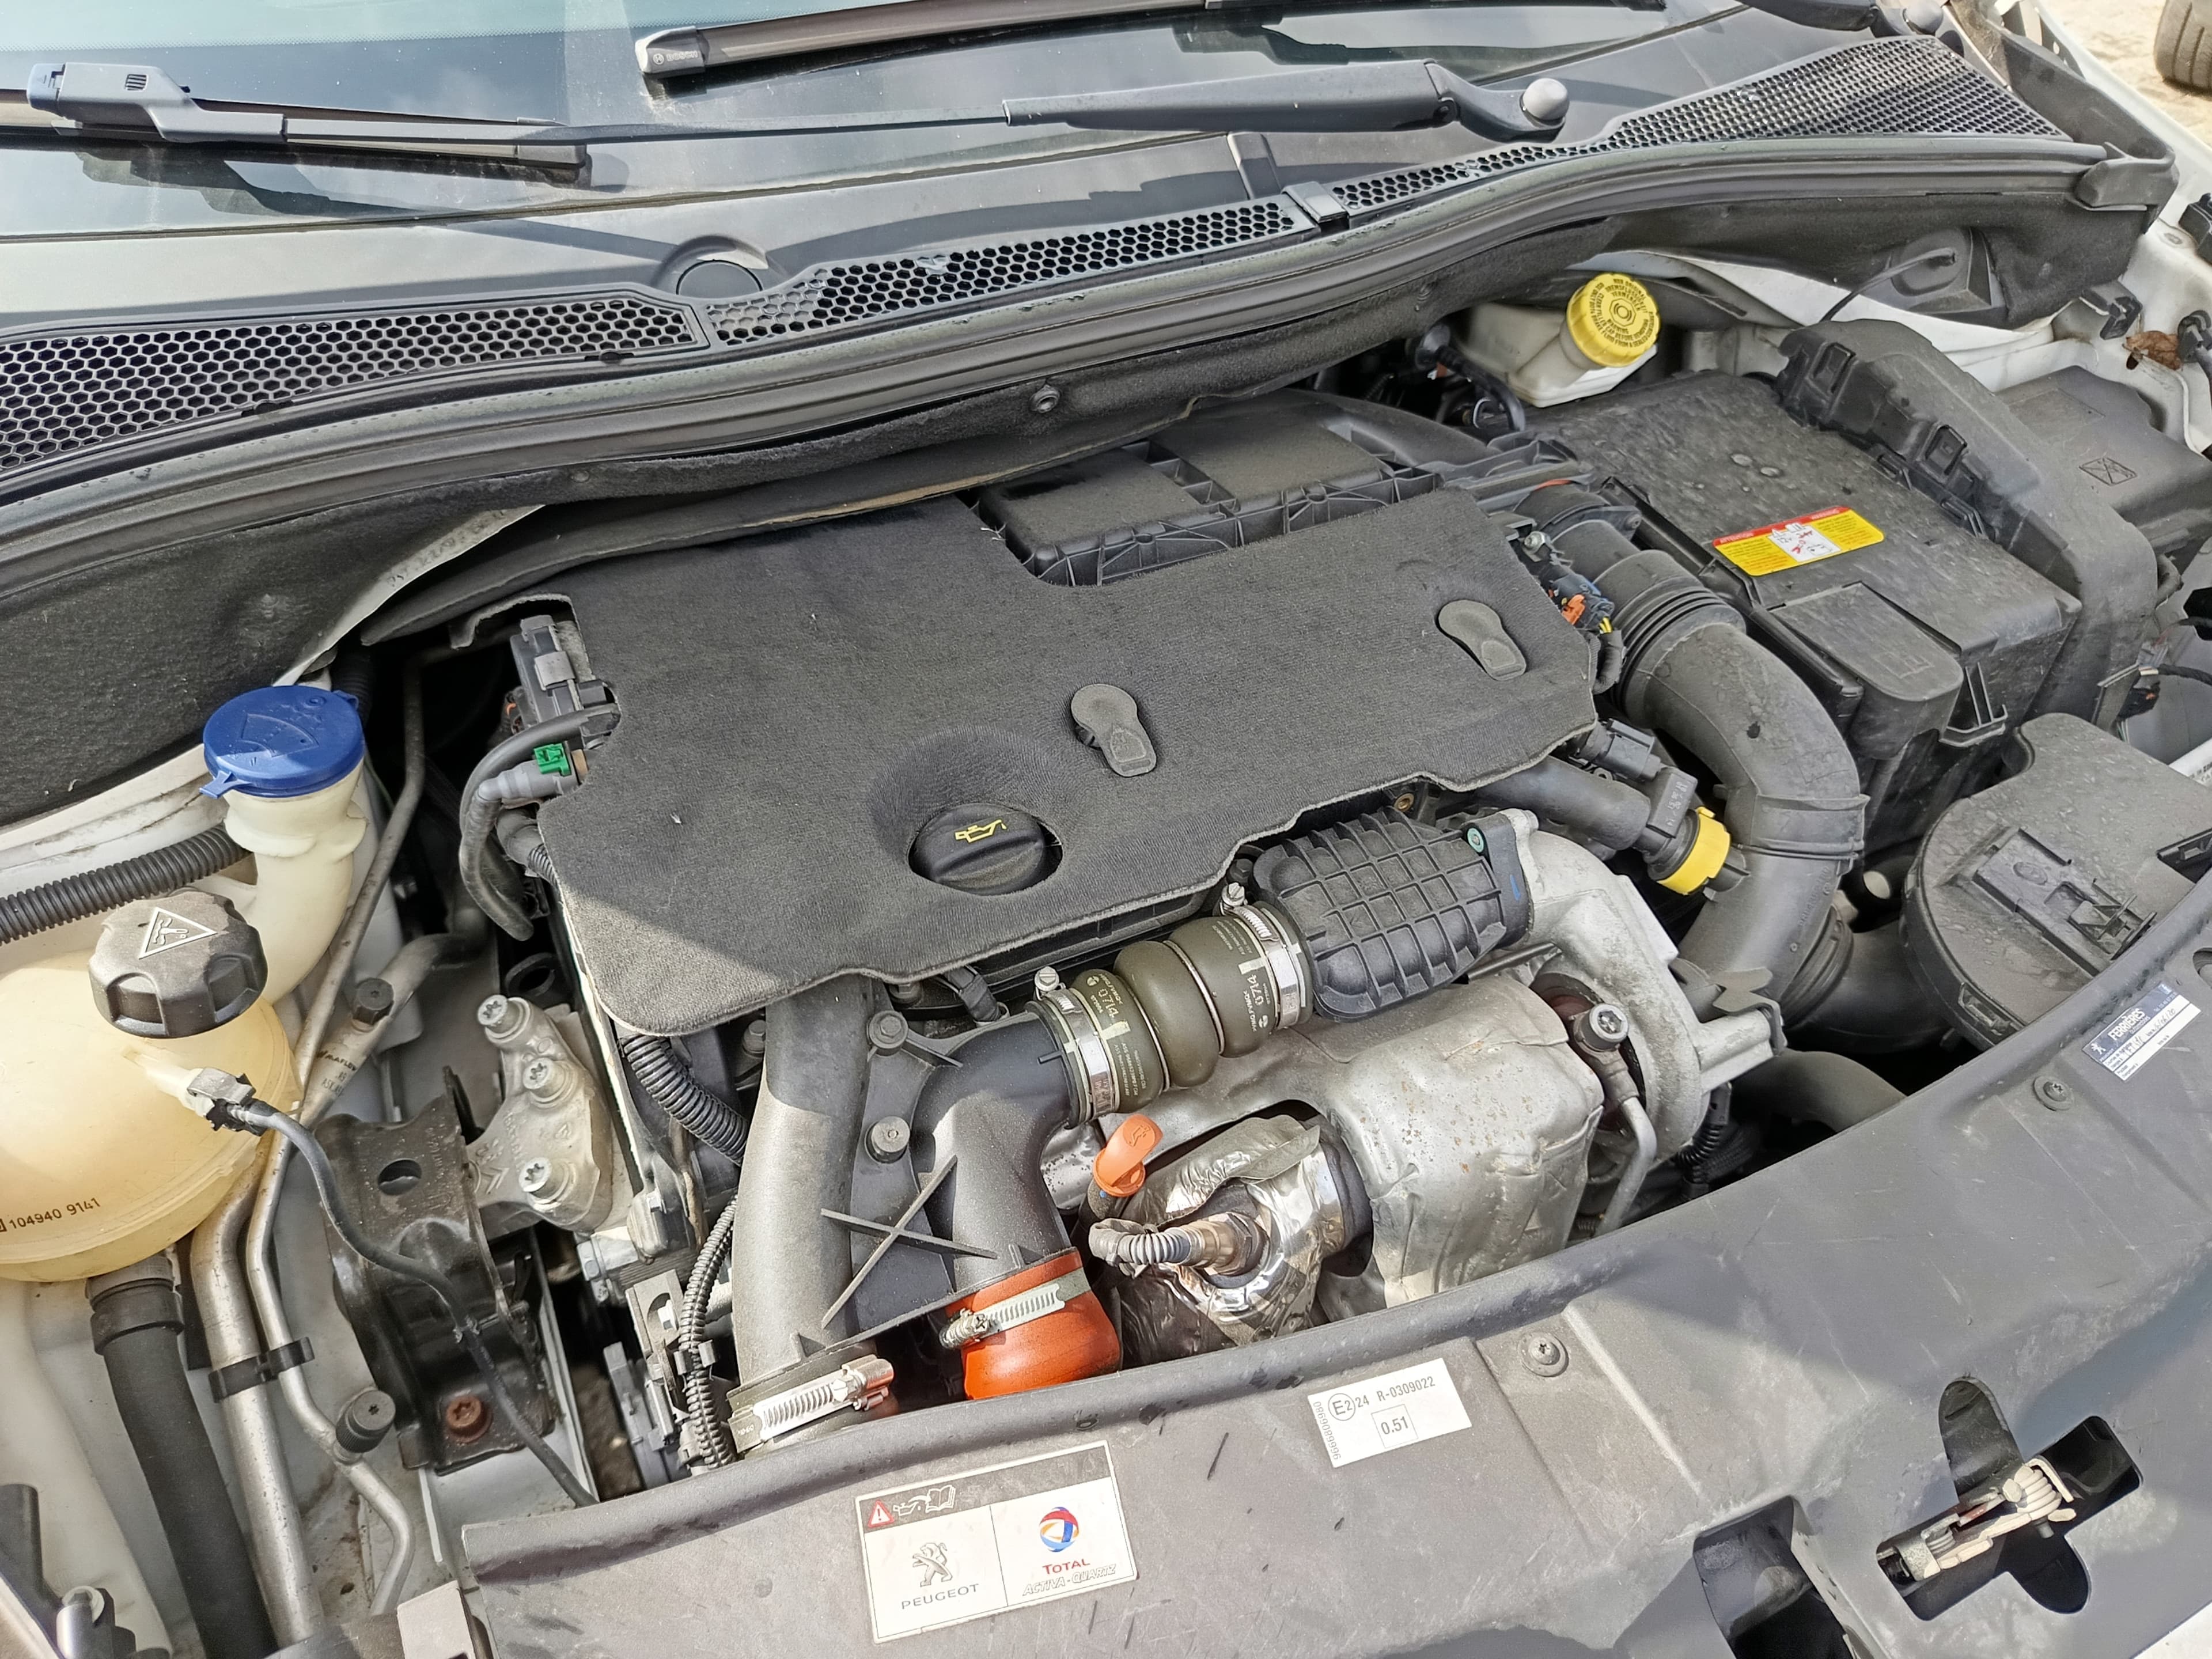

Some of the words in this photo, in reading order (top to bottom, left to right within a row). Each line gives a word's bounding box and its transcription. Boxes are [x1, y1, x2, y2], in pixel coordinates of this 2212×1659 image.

[1099, 988, 1119, 1018] 0714
[2108, 1008, 2146, 1041] FERRIÈRES
[9, 1209, 62, 1229] 104940
[66, 1198, 101, 1215] 9141
[1355, 1394, 1370, 1408] 24
[1376, 1376, 1436, 1402] R-0309022
[1312, 1401, 1342, 1460] 9666806980
[1380, 1416, 1409, 1435] 0.51
[1042, 1558, 1090, 1575] TOTAL
[901, 1583, 979, 1609] PEUGEOT
